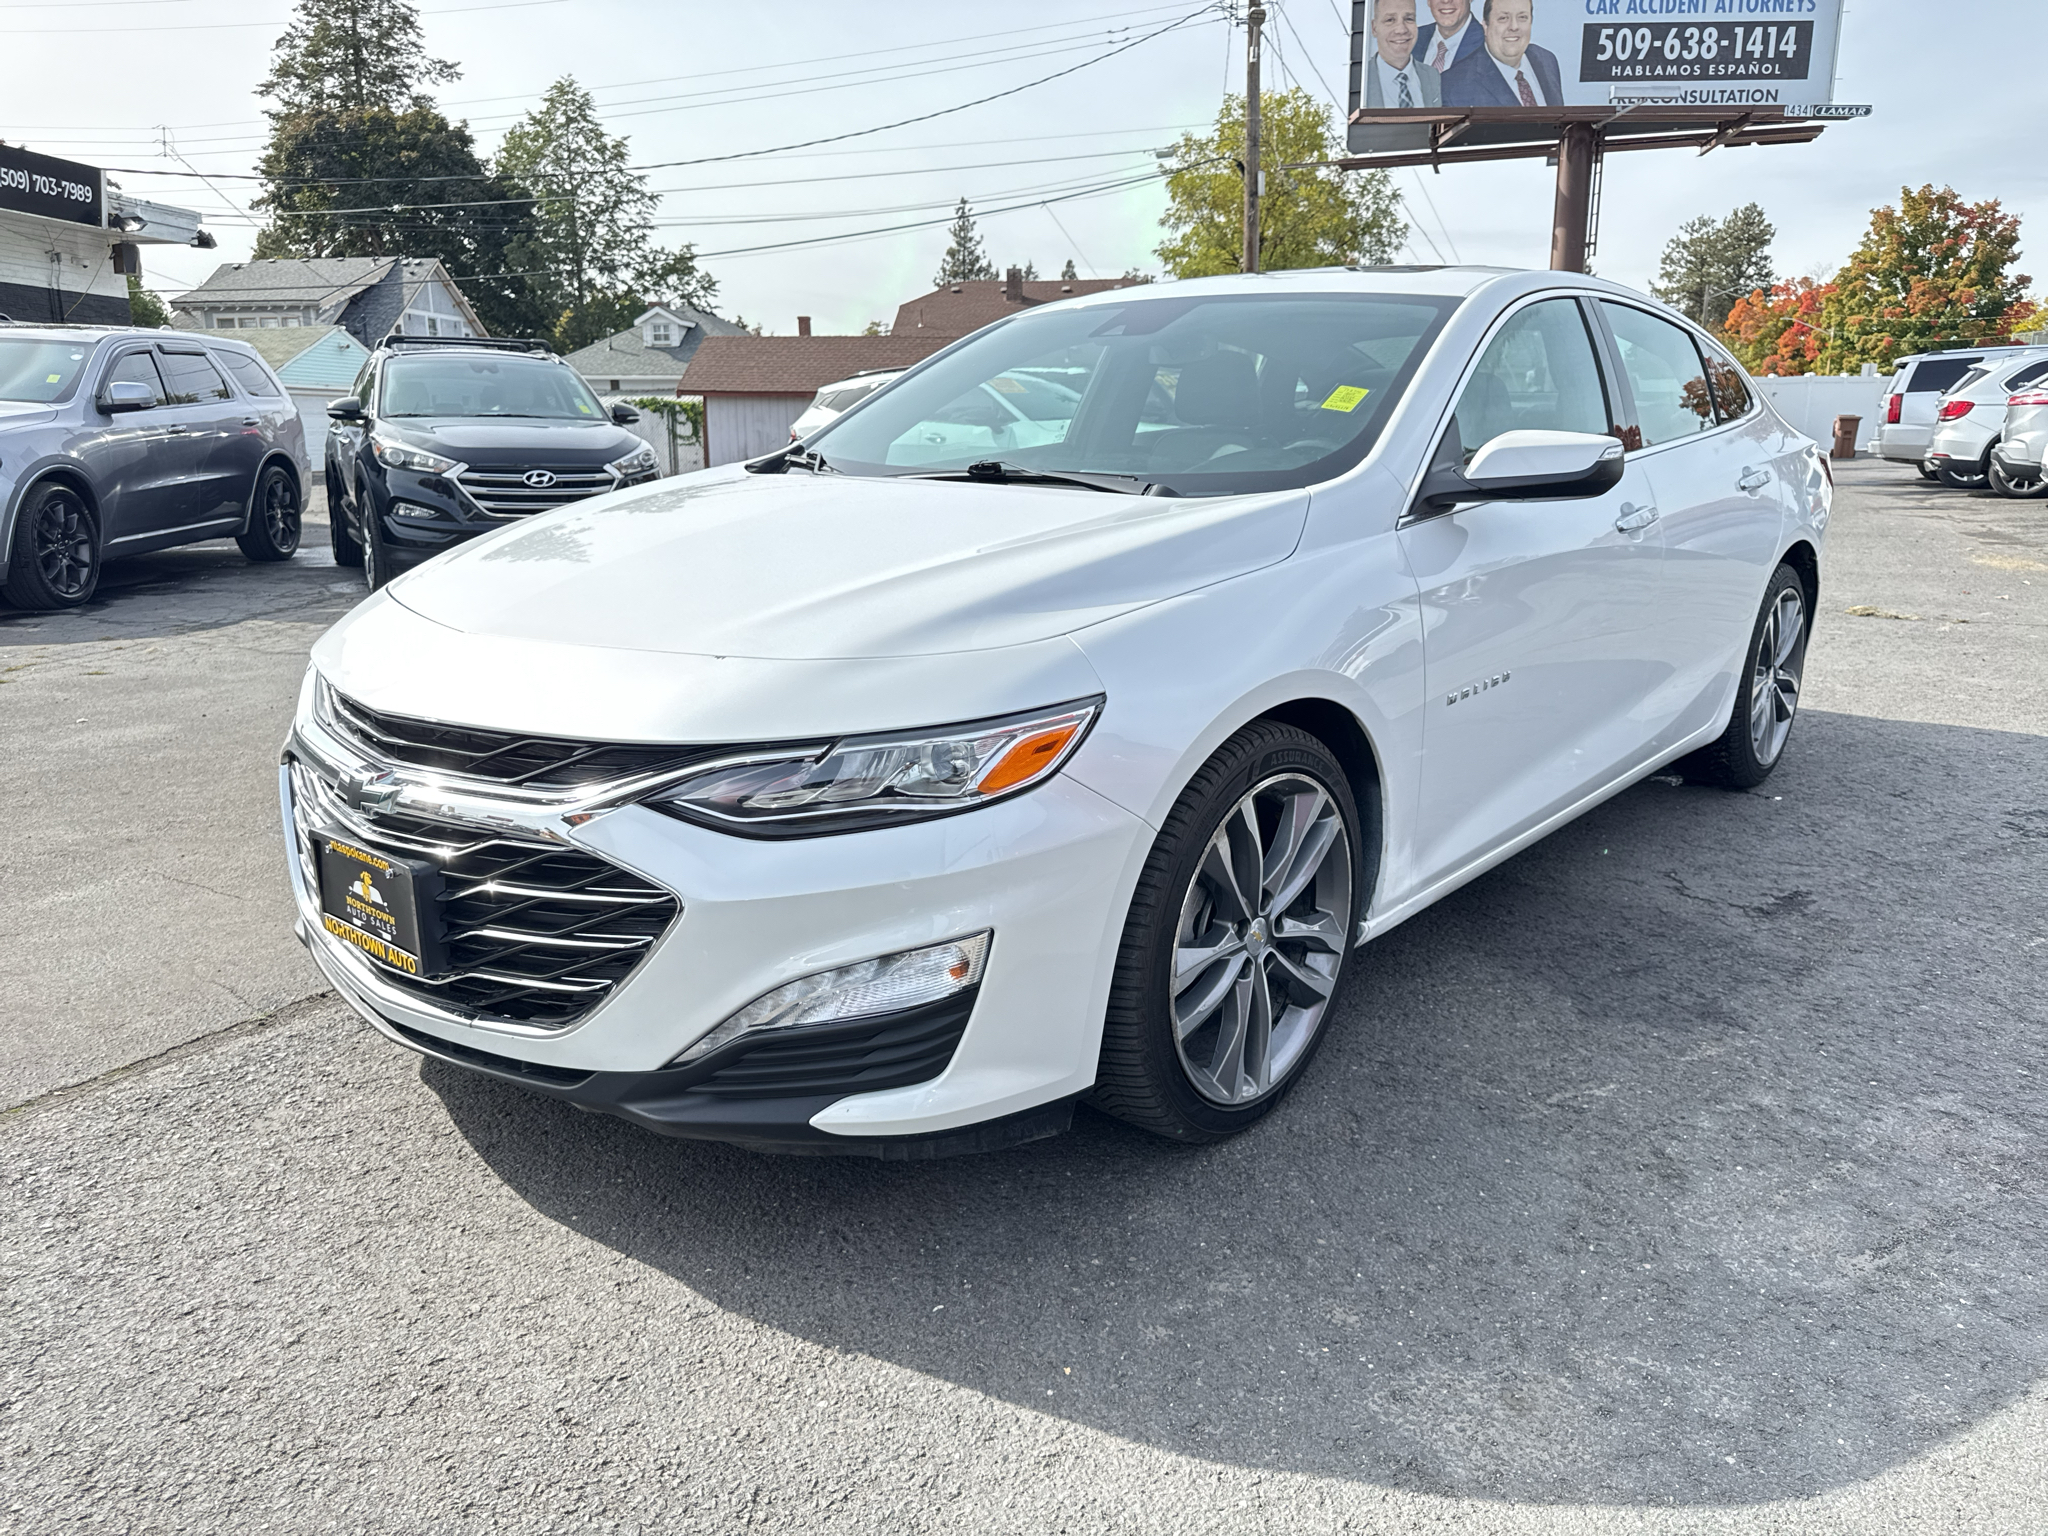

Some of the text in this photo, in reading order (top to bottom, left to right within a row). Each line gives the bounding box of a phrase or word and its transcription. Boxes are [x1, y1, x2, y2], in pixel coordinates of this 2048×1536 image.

[1585, 0, 1620, 15] CAR
[1626, 0, 1708, 14] ACCIDENT
[1596, 26, 1797, 61] 509-638-1414
[1611, 61, 1781, 77] HABLAMOS ESPAÑOL
[1820, 107, 1867, 116] LAMAR
[32, 173, 93, 203] 703-7989
[1270, 750, 1326, 773] ASSURANCE
[345, 895, 396, 925] NORTHTOWN
[346, 904, 397, 936] AUTO SALES
[324, 916, 416, 974] NORTHTOWN AUTO
